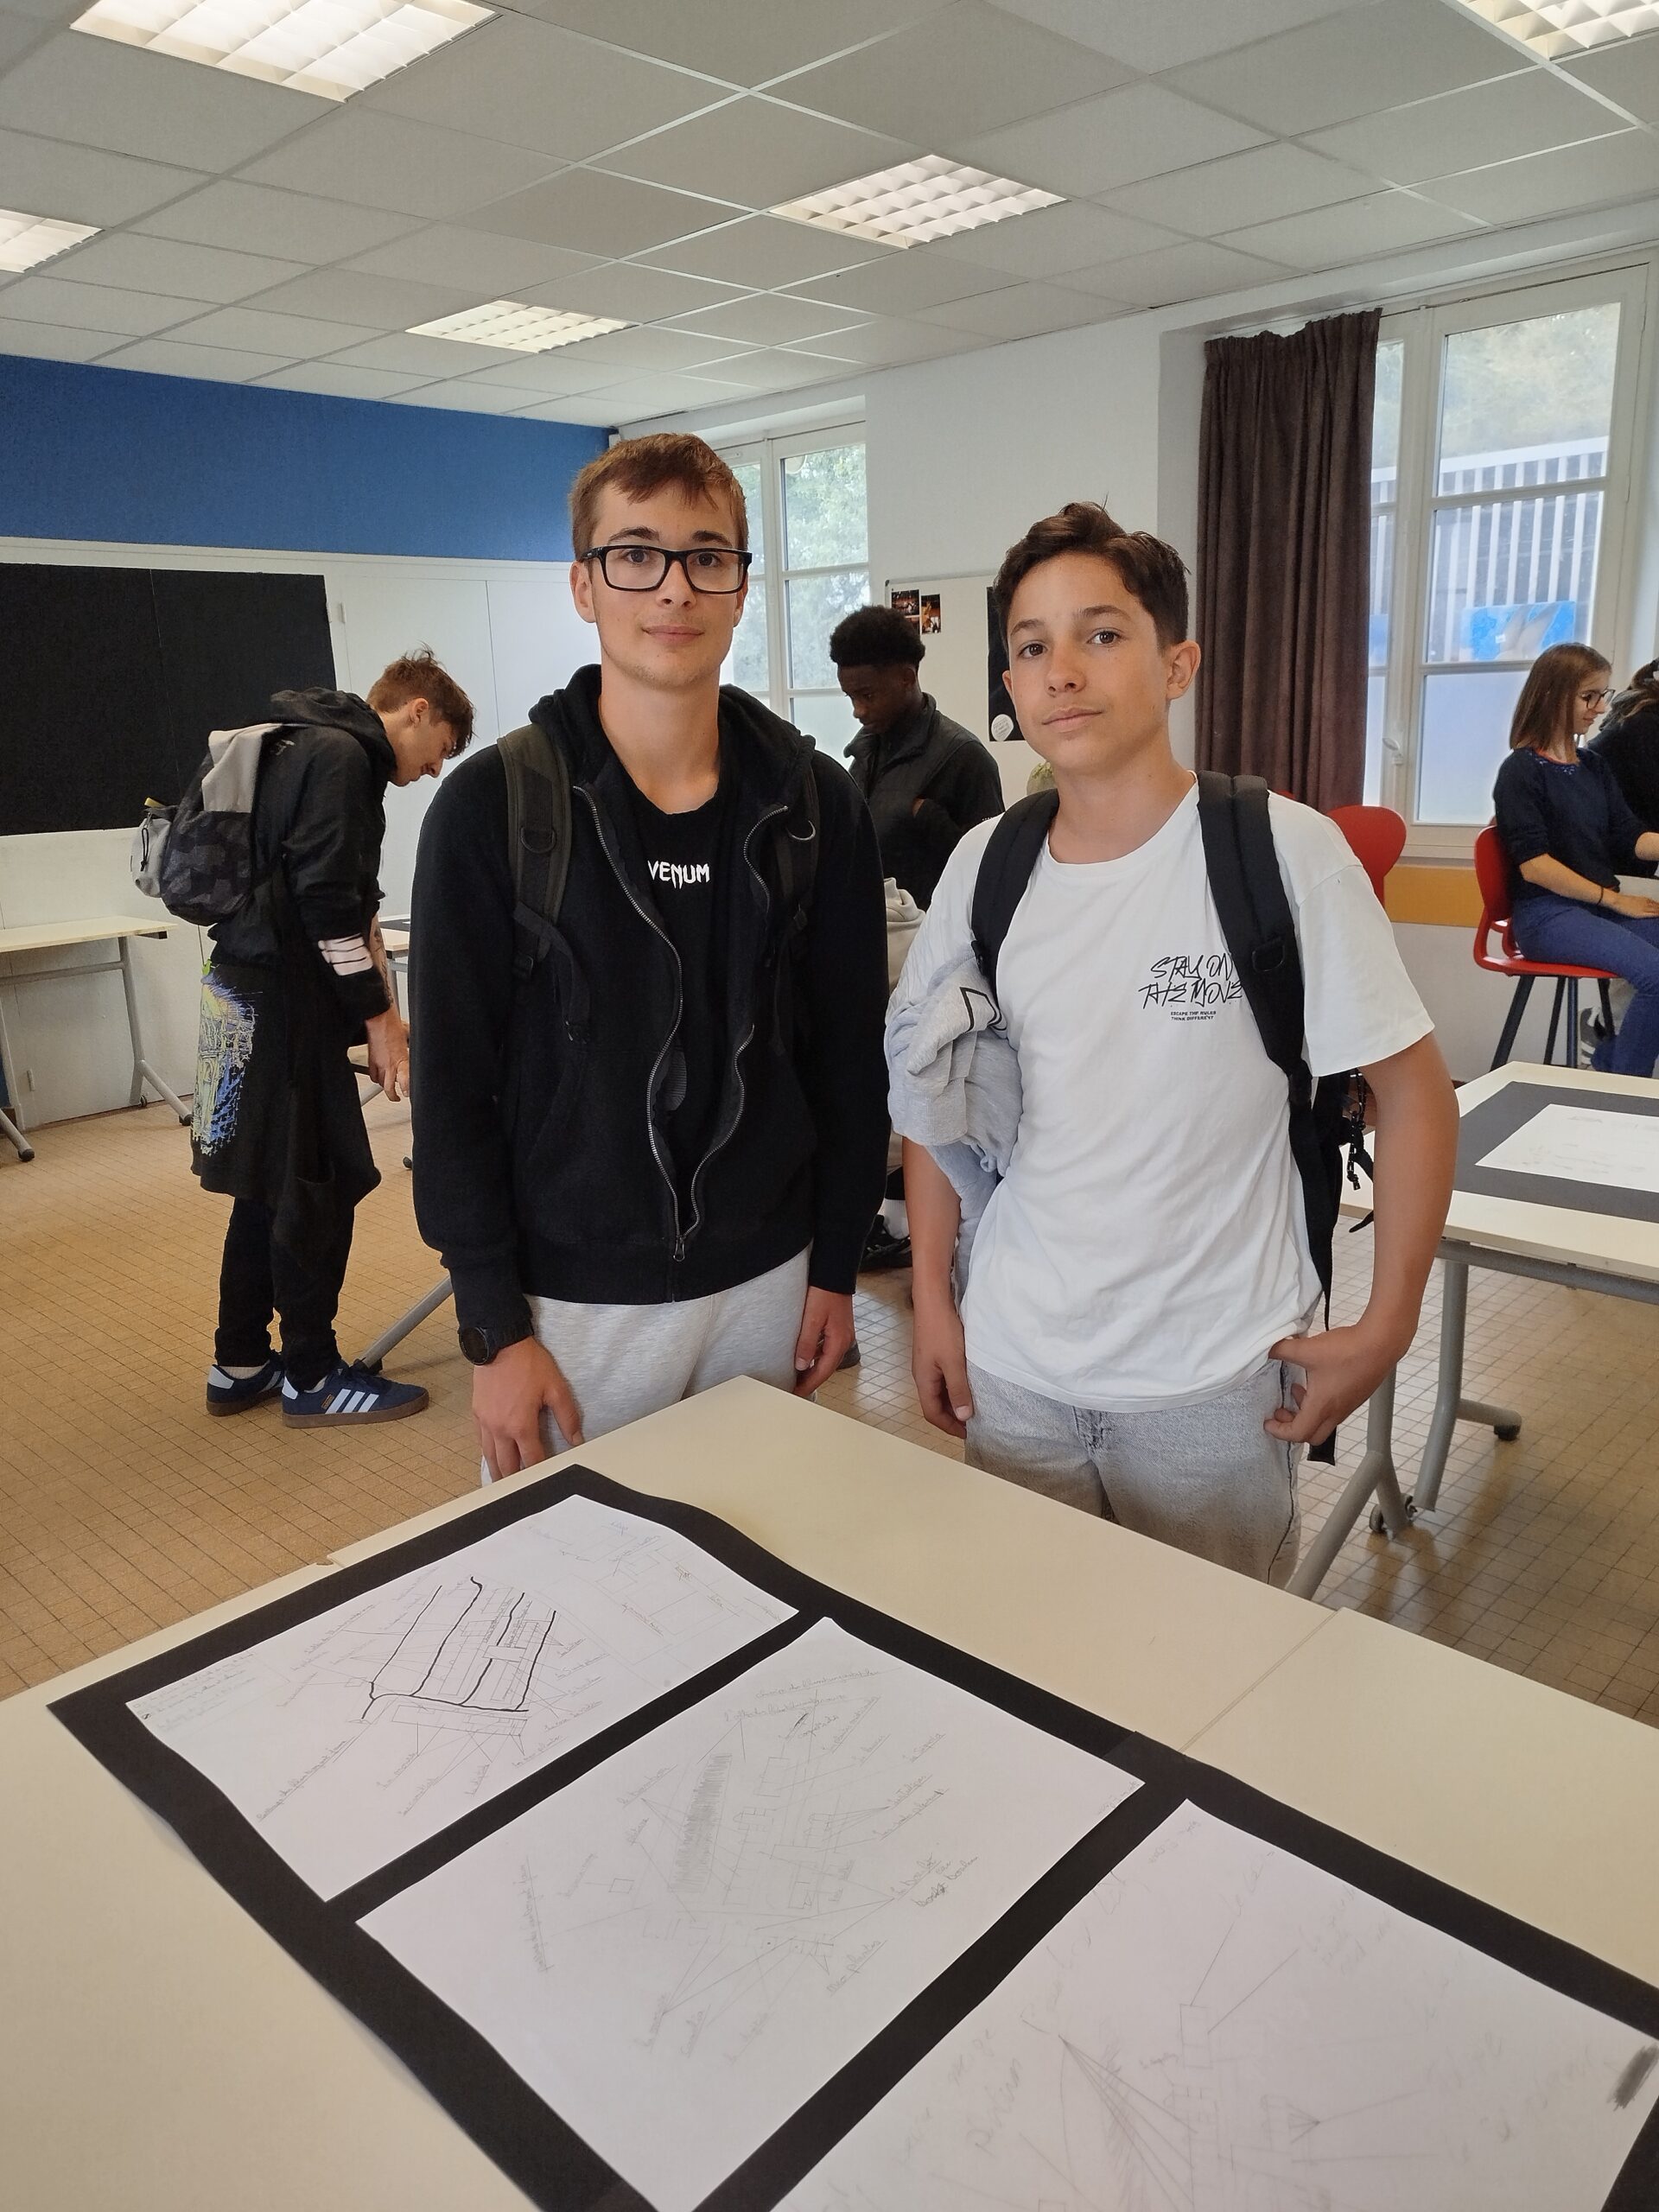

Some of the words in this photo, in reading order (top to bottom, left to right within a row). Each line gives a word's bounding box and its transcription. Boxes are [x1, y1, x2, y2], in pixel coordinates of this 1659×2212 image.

[647, 860, 710, 889] VENUM
[1150, 955, 1204, 982] STAY
[1206, 952, 1234, 981] ON
[1138, 982, 1188, 1009] THE
[1191, 978, 1243, 1007] MOVE
